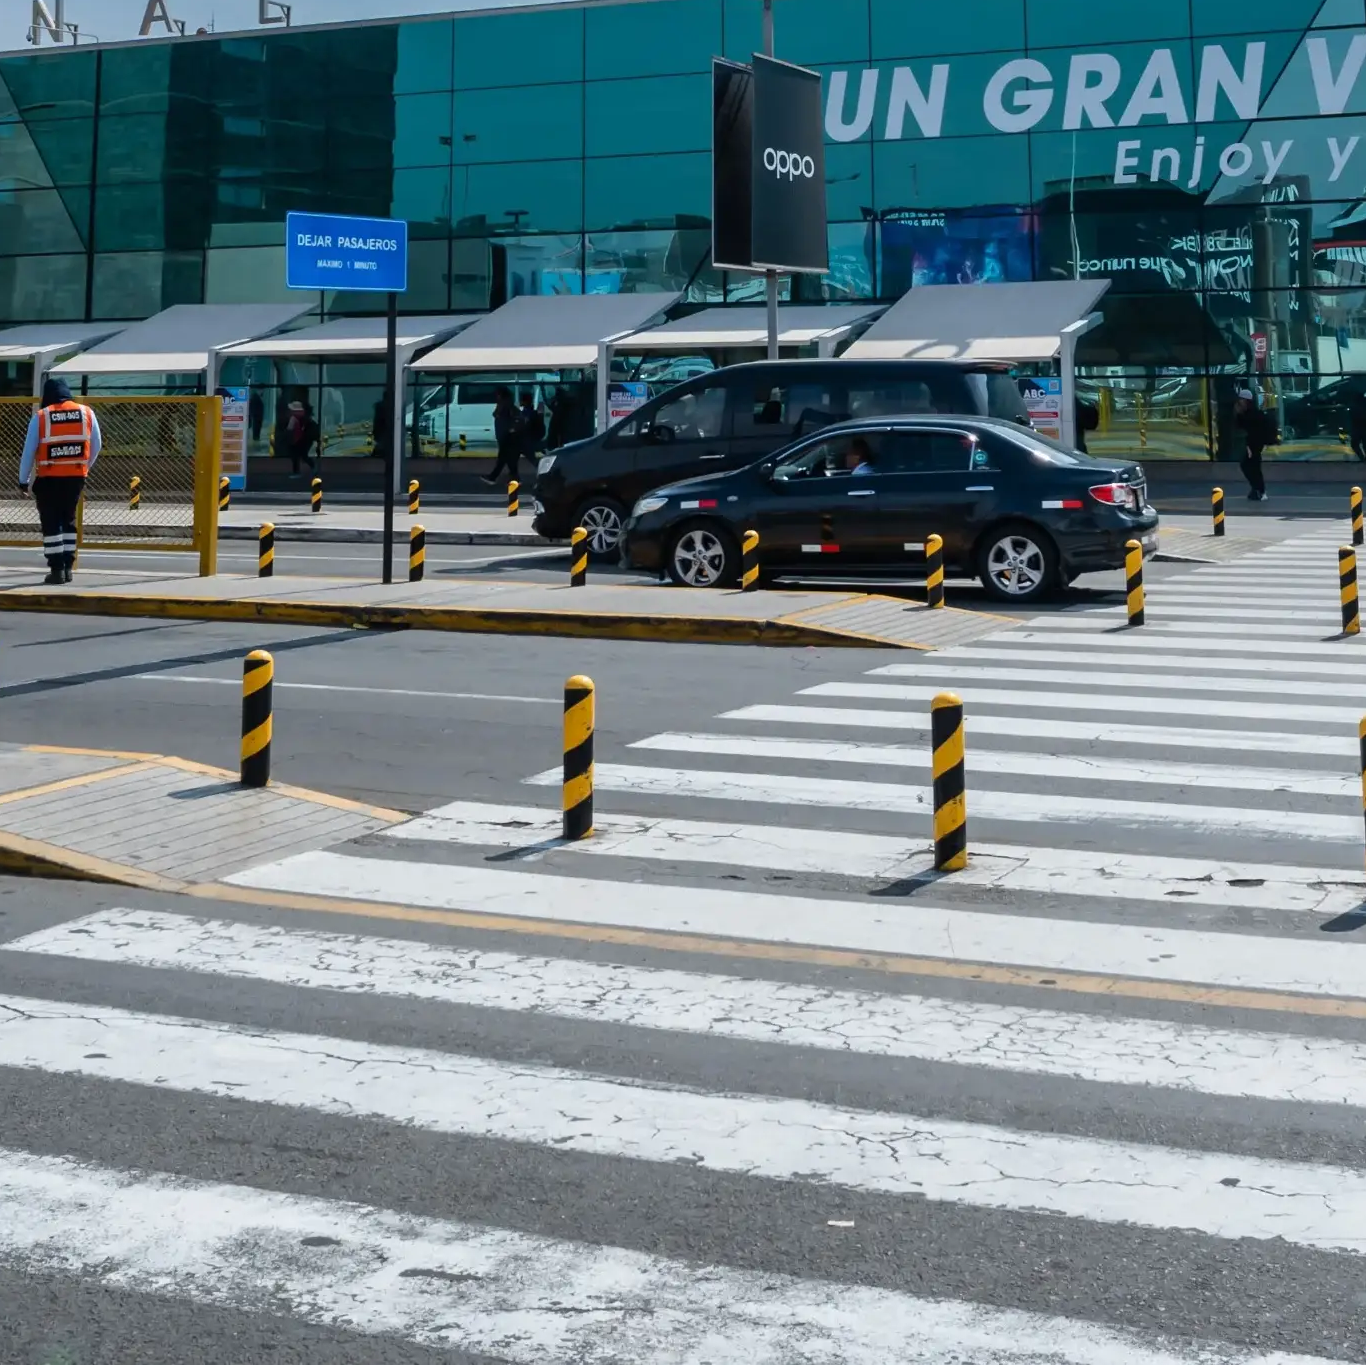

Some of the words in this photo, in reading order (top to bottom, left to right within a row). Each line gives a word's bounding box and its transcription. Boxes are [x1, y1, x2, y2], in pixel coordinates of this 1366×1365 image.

[982, 42, 1267, 135] GRAN
[763, 147, 815, 181] oppo
[1113, 133, 1296, 190] Enjoy
[297, 234, 332, 247] DEJAR
[337, 236, 397, 251] PASAJEROS
[353, 260, 378, 270] MINUTO
[1023, 389, 1046, 398] ABC
[51, 445, 82, 453] CLEAN
